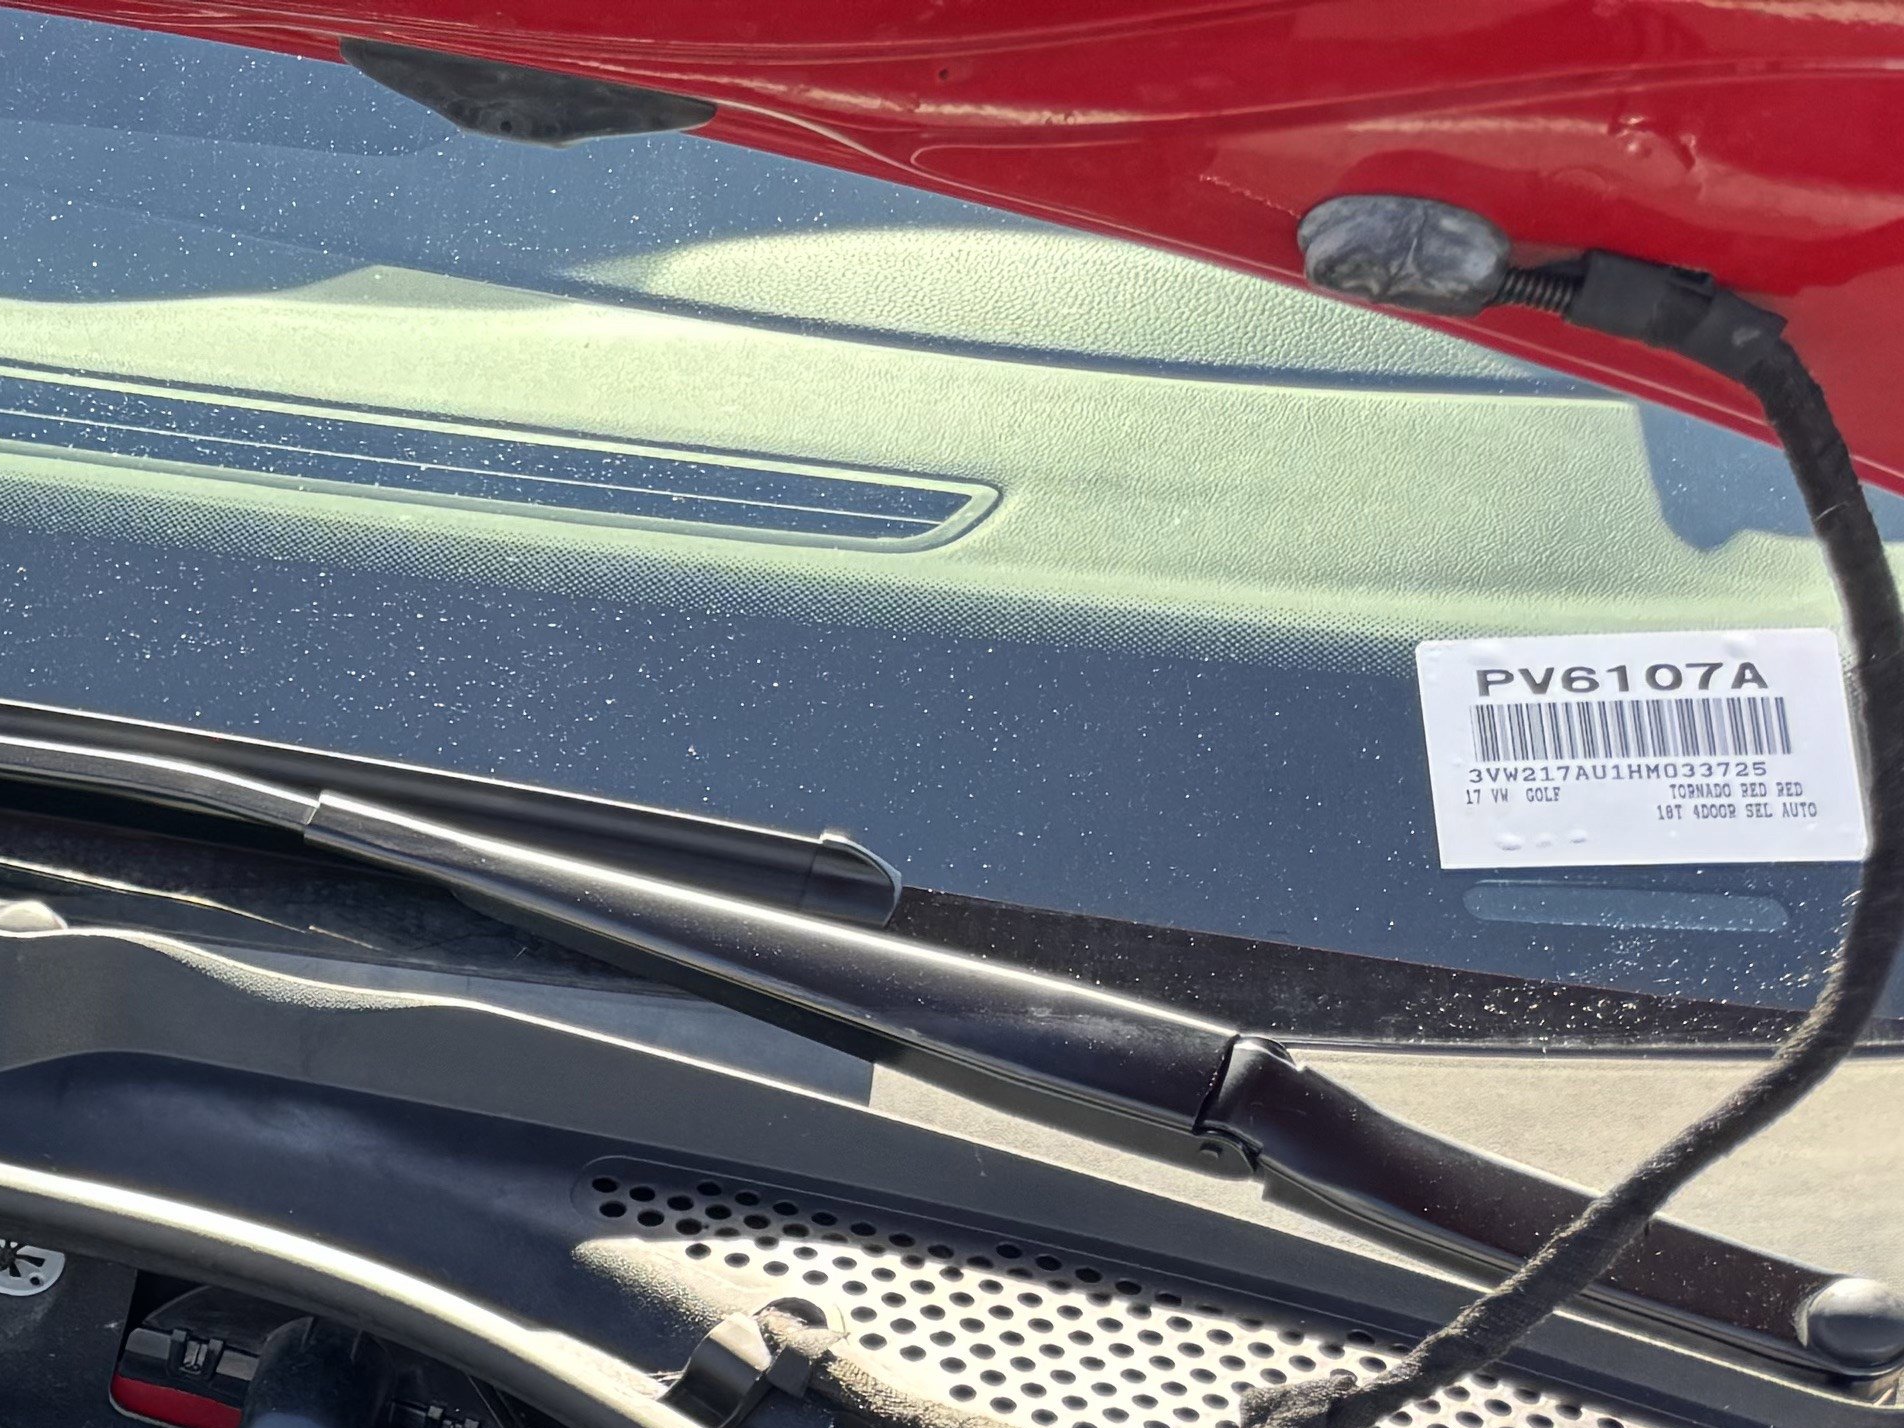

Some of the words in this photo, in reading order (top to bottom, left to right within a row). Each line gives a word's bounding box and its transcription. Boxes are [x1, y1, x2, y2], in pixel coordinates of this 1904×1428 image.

[1475, 661, 1768, 697] PV6107A
[1465, 787, 1481, 805] 17
[1490, 786, 1509, 804] VW
[1524, 785, 1561, 803] GOLF
[1668, 781, 1732, 799] TORNADO
[1739, 781, 1768, 798] RED
[1774, 780, 1803, 797] RED
[1692, 802, 1736, 819] 4DOOR
[1781, 800, 1818, 818] AUTO
